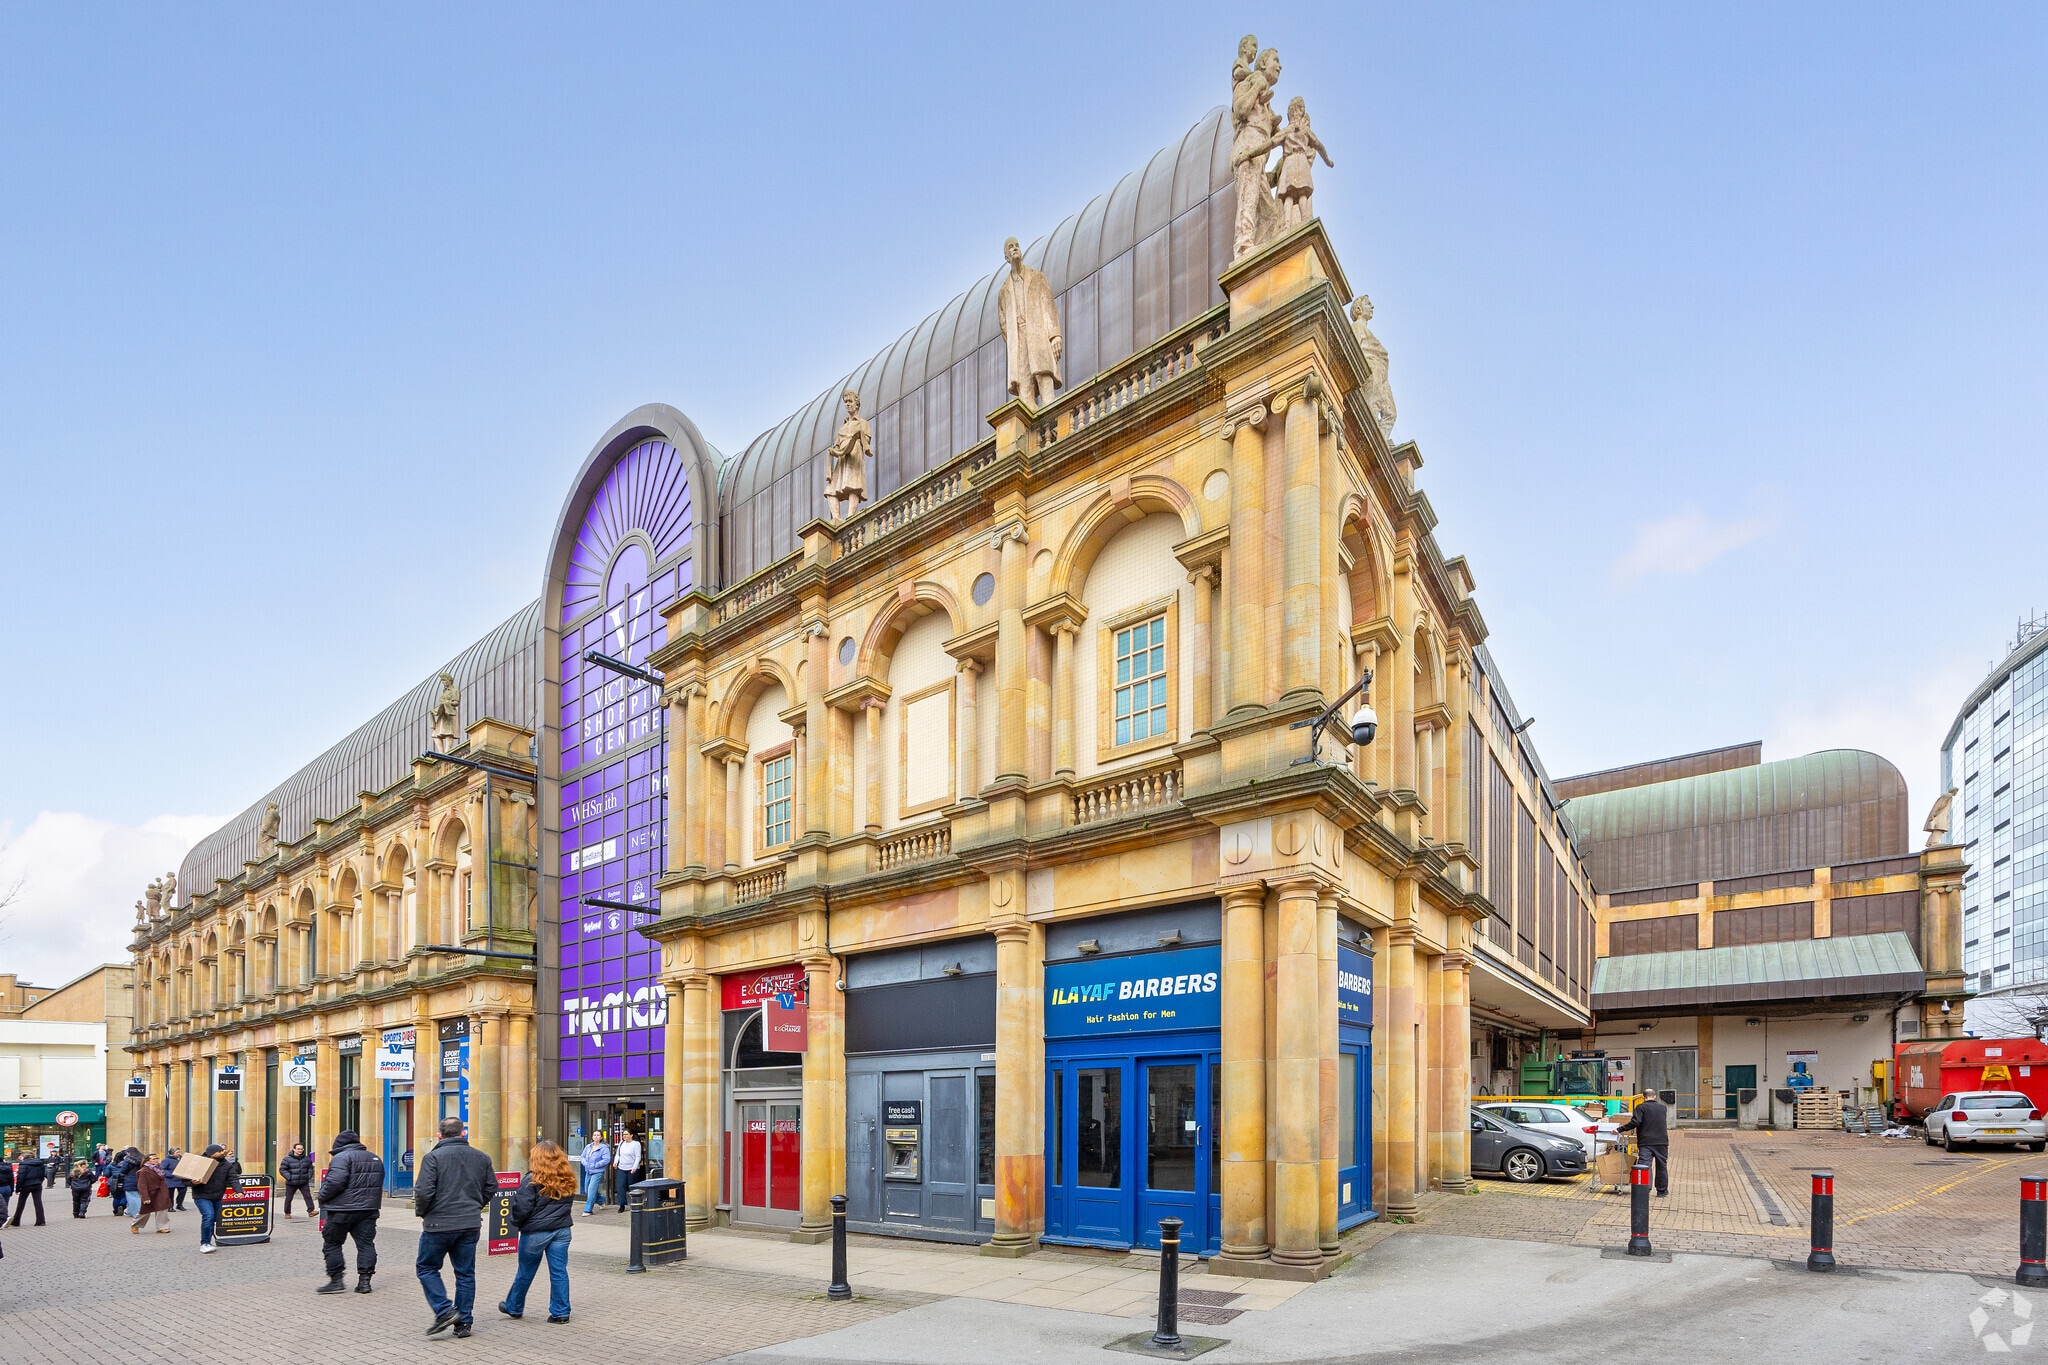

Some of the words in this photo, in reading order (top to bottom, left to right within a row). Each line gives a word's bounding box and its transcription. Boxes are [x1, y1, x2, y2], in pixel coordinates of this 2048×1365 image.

[584, 684, 660, 737] SHOPPIN
[595, 709, 659, 756] CENTRE
[571, 792, 617, 823] WHSmith
[1051, 982, 1116, 1006] ILAYAF
[1118, 972, 1218, 1001] BARBERS
[1338, 970, 1371, 996] BARBERS
[1086, 1015, 1104, 1024] Hair
[1107, 1012, 1139, 1022] Fashion
[1143, 1010, 1157, 1019] for
[1161, 1010, 1176, 1018] Men
[888, 1106, 901, 1114] free
[901, 1106, 915, 1114] cash
[751, 1122, 766, 1131] SALE
[239, 1178, 260, 1186] PEN
[221, 1207, 265, 1217] GOLD
[499, 1198, 510, 1236] GOLD
